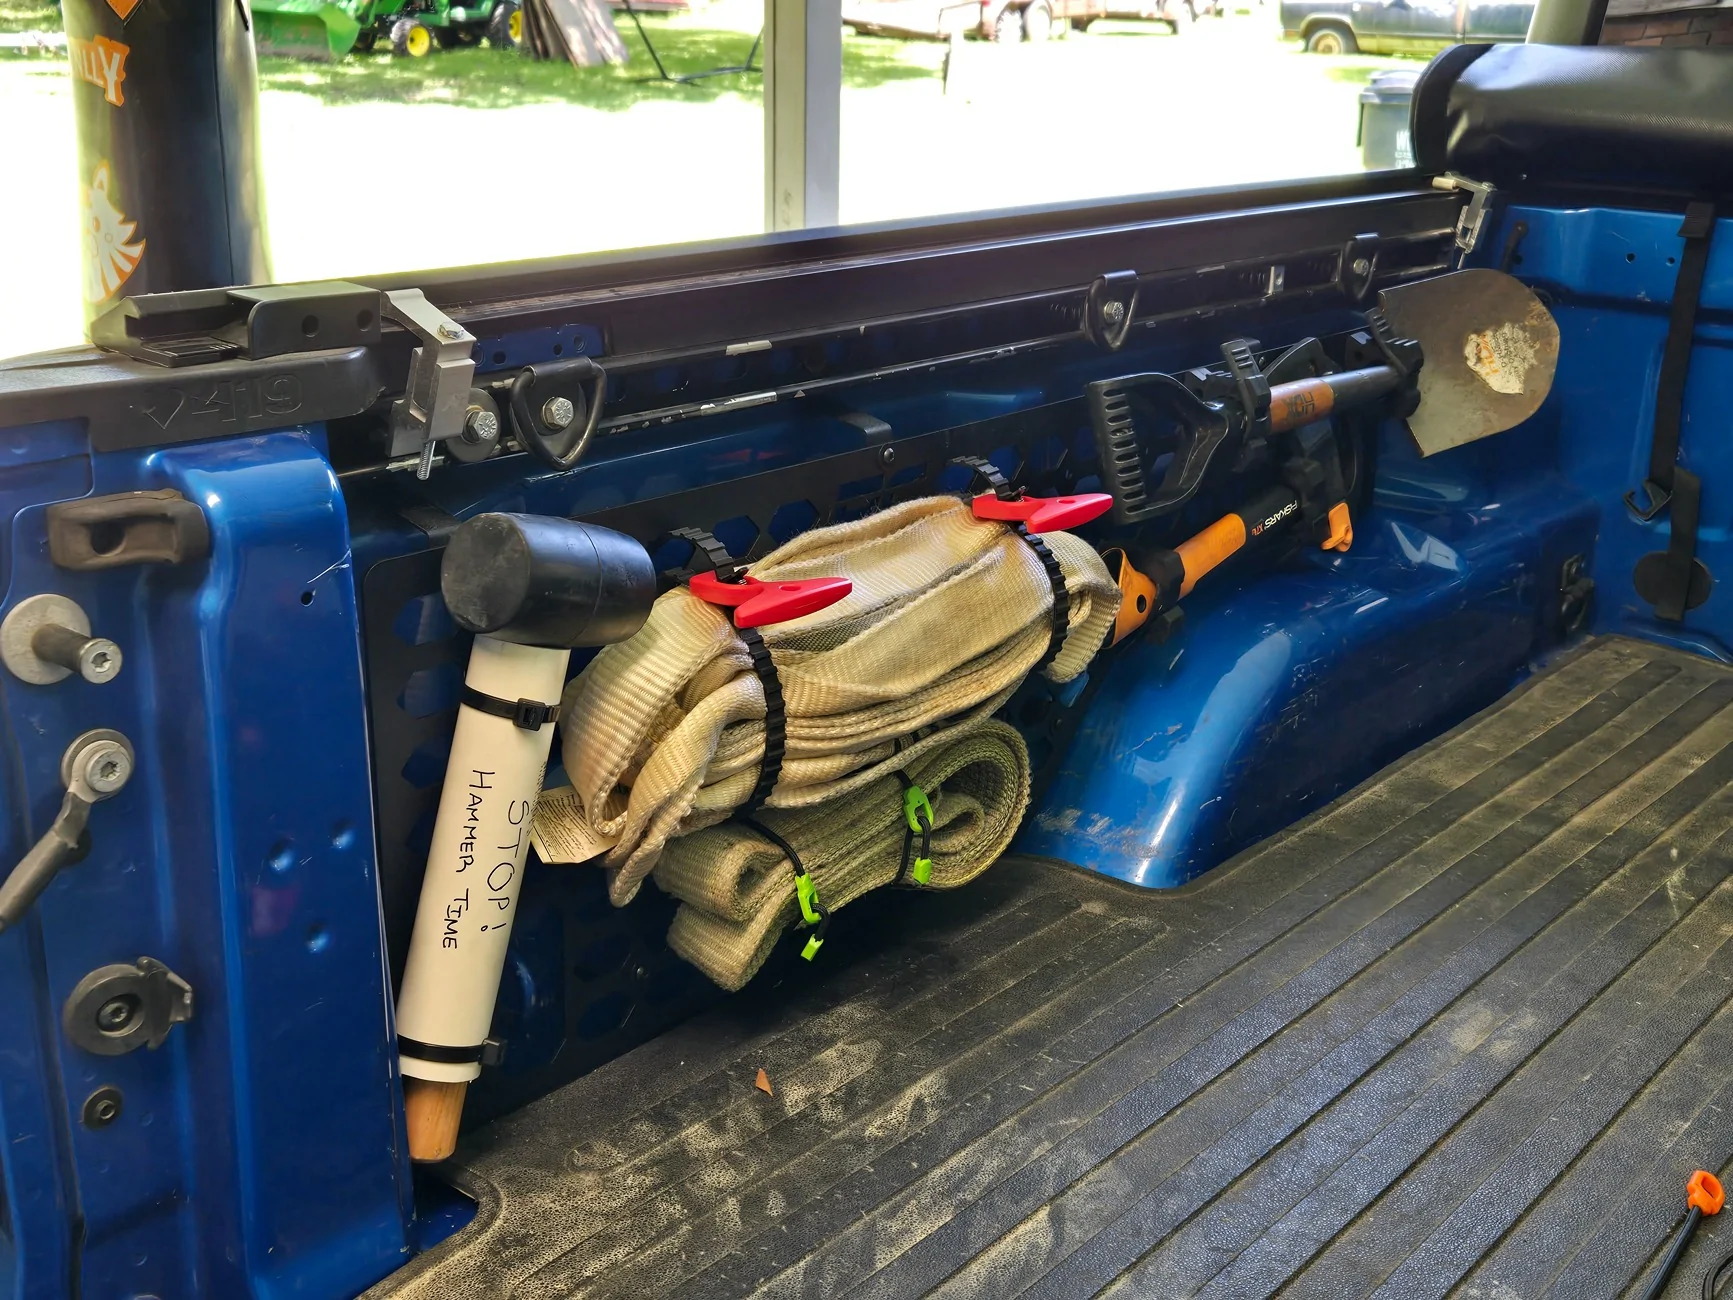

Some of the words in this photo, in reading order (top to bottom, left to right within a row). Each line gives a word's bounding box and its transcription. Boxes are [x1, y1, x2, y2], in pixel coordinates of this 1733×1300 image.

[1264, 500, 1298, 530] FISKARS
[455, 769, 496, 873] HAMMER
[480, 800, 530, 932] STOP!
[442, 887, 470, 949] TIME
